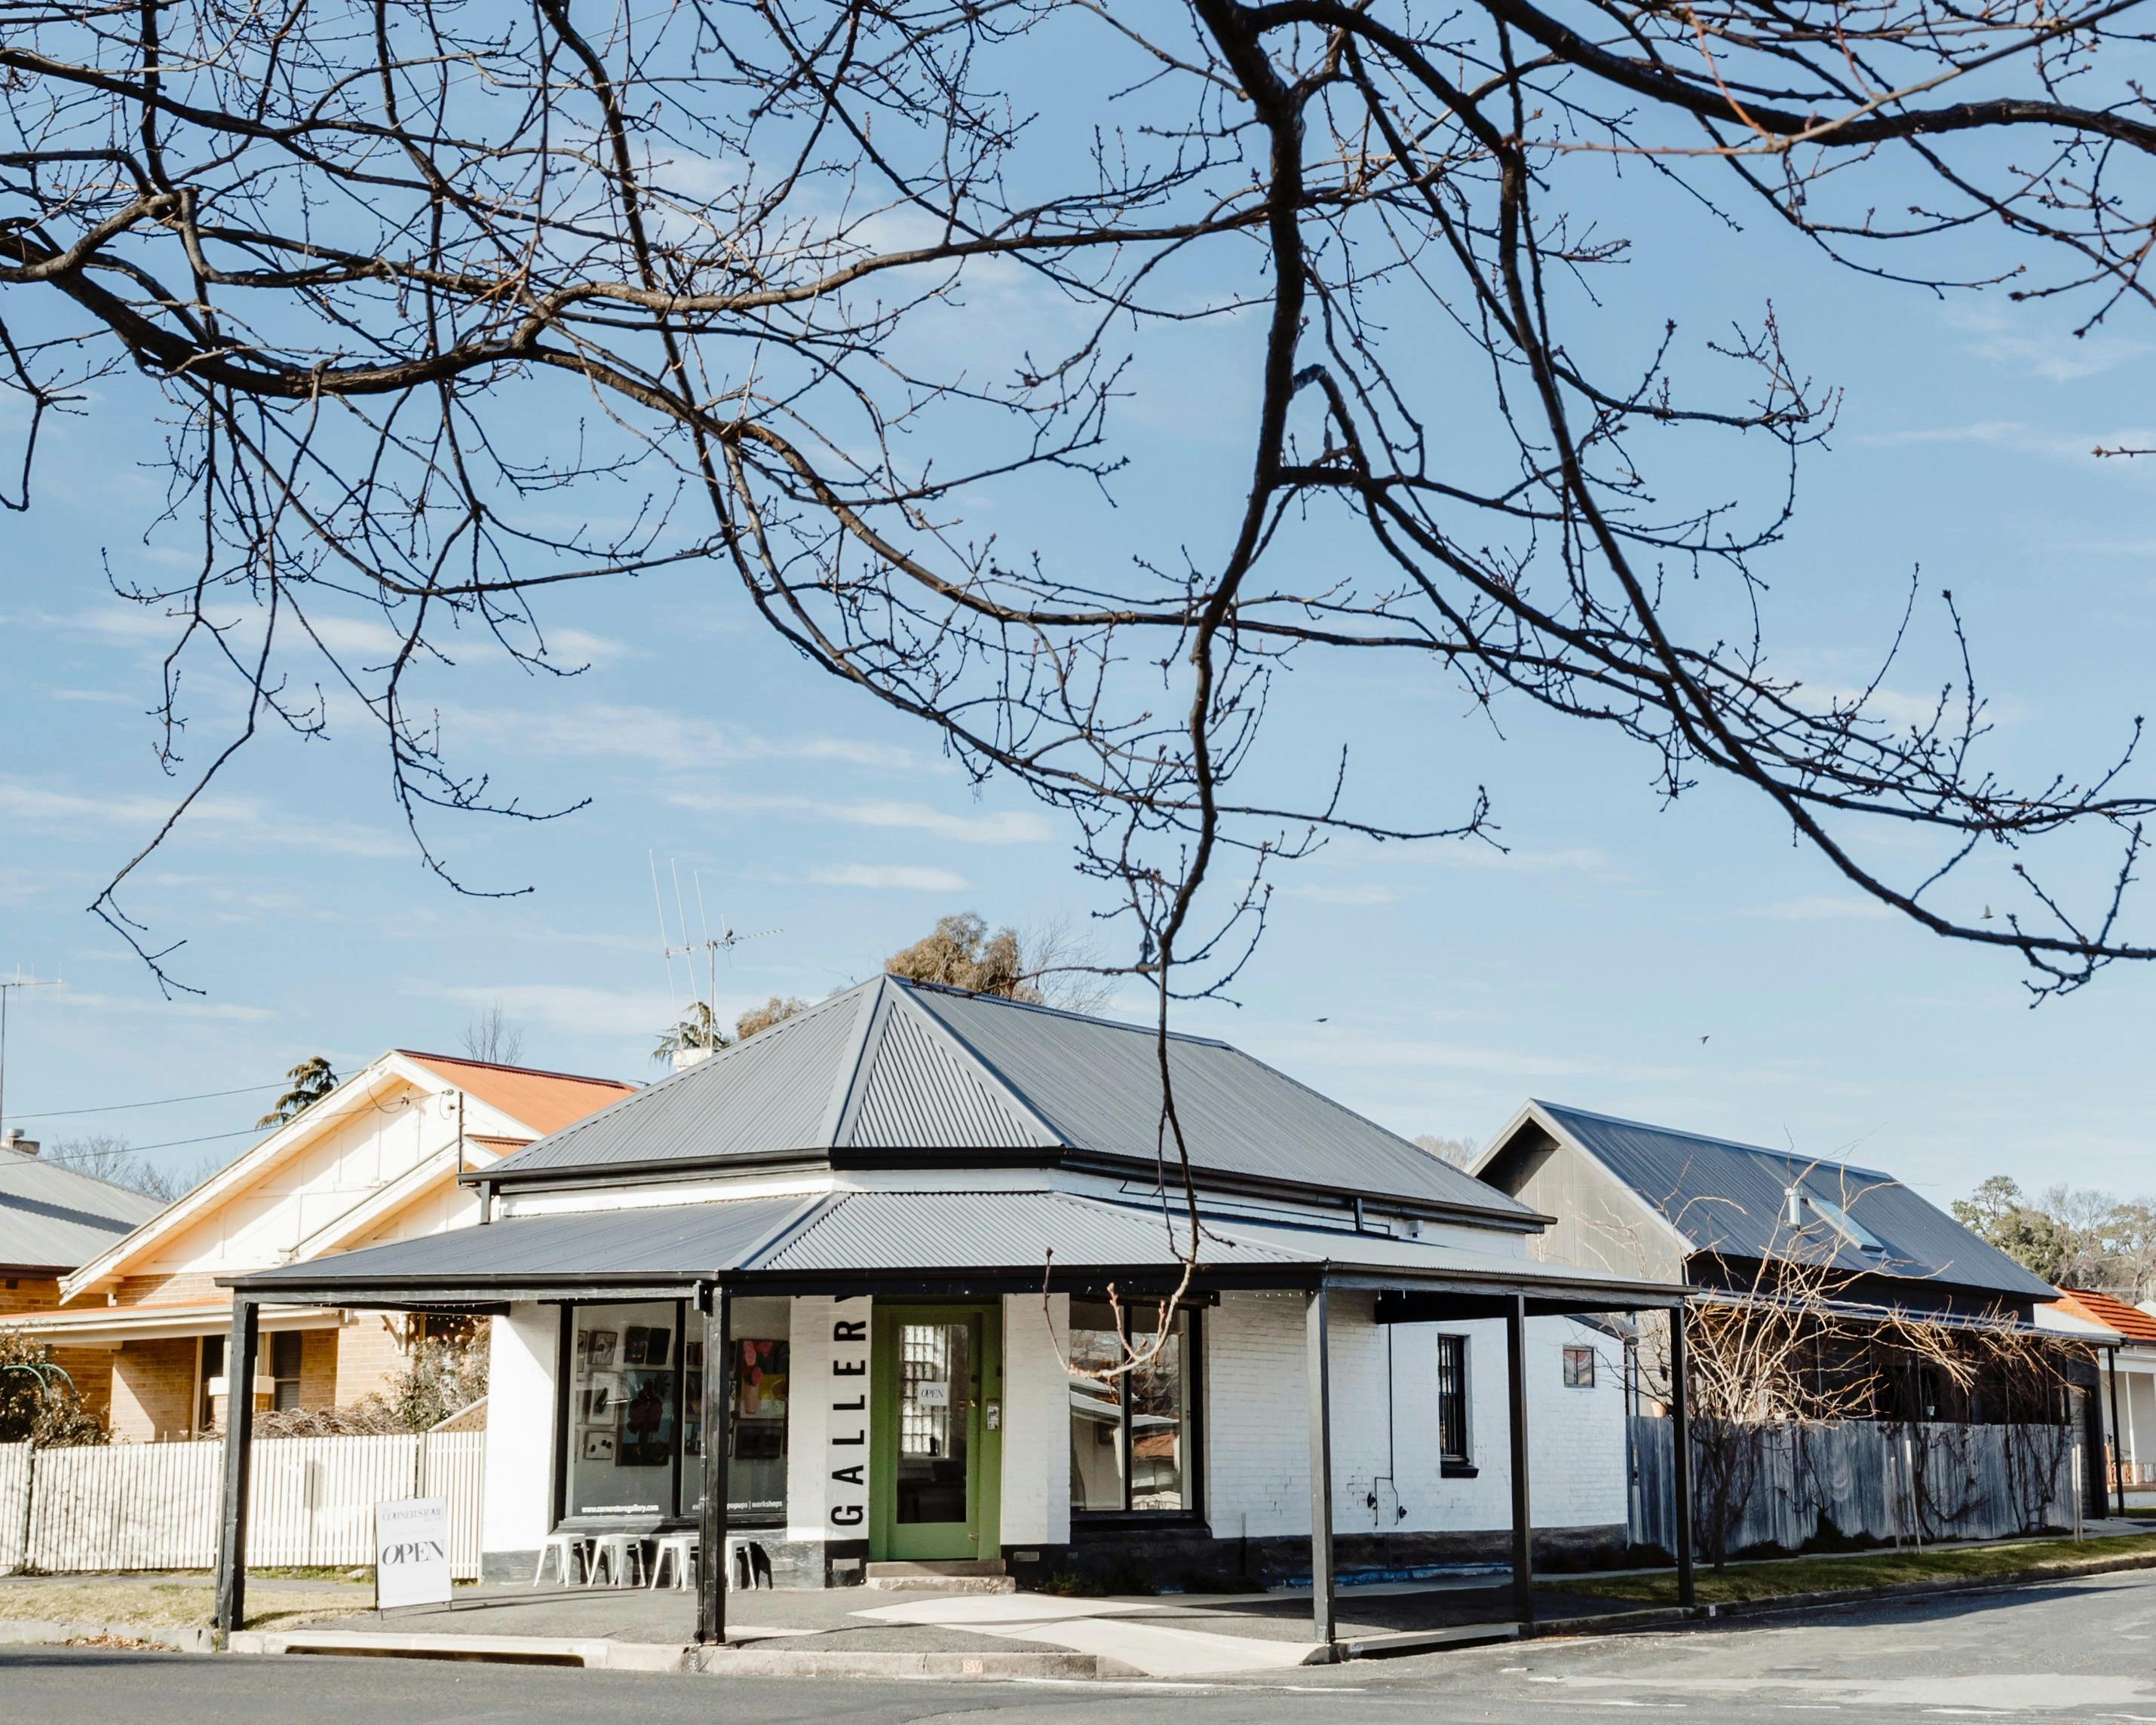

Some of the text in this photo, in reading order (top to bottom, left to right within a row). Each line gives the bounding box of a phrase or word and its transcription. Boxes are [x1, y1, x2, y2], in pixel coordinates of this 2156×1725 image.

[921, 1389, 943, 1399] OPEN
[382, 1540, 444, 1566] OPEN
[965, 1660, 981, 1671] SV
